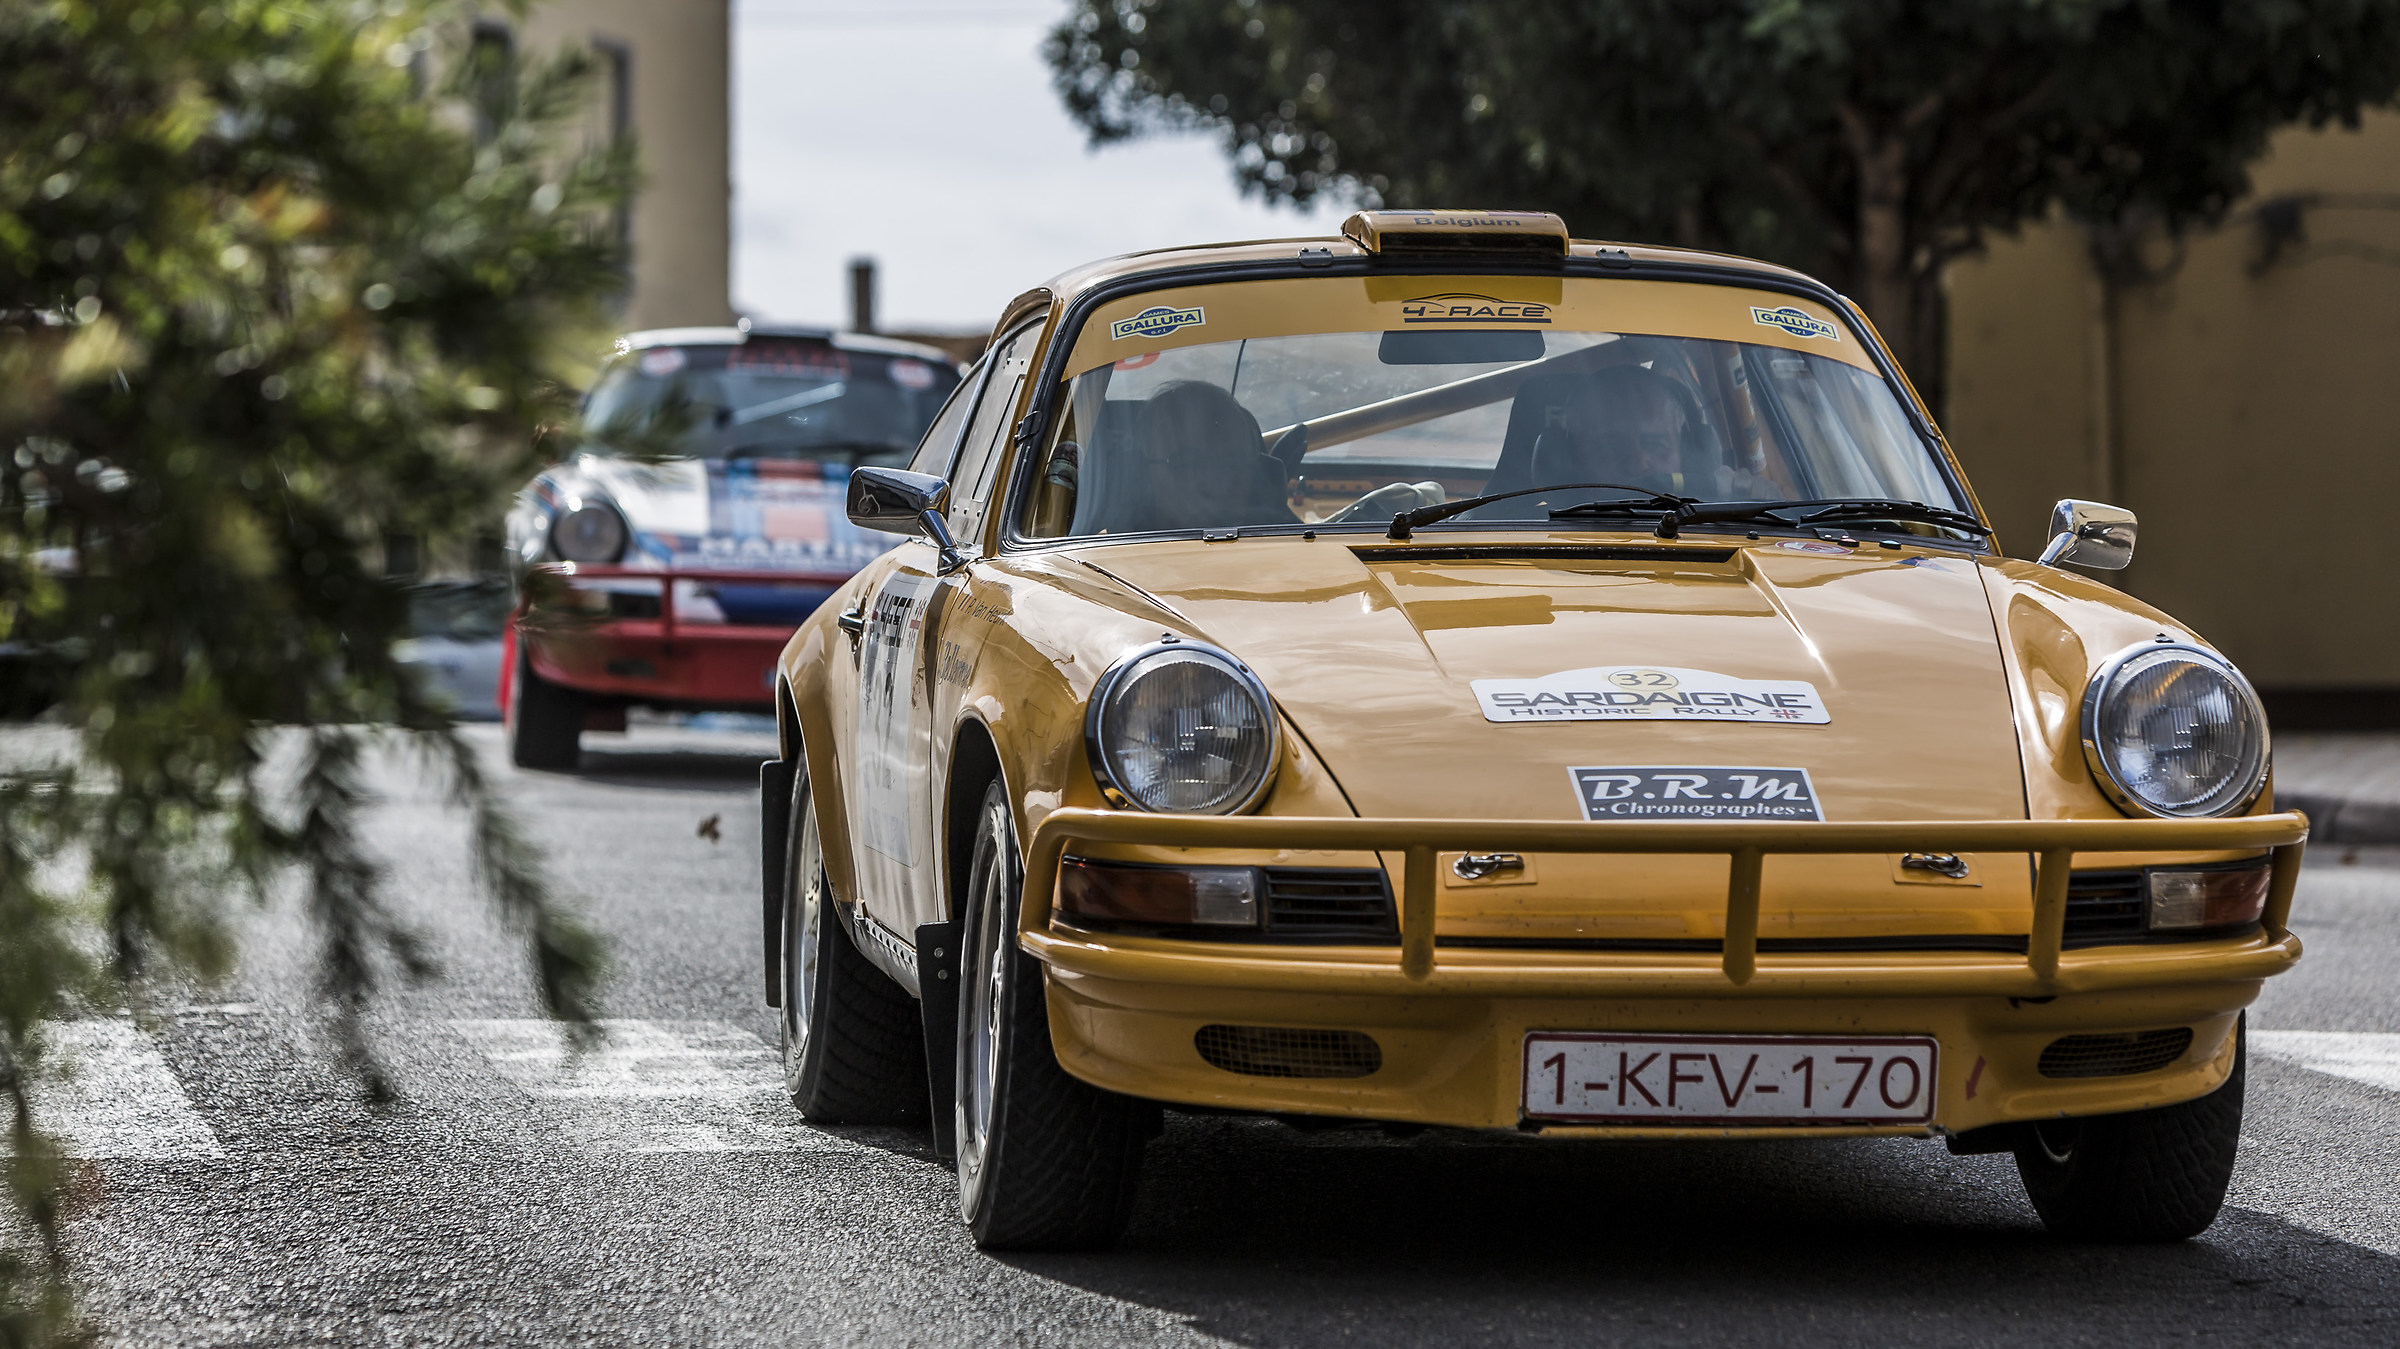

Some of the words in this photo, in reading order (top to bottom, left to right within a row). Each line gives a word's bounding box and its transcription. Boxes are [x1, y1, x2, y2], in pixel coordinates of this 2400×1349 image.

[1413, 217, 1521, 227] Belgium
[1402, 306, 1546, 317] 4-RACE
[1120, 313, 1197, 333] GALLURA
[1760, 313, 1832, 335] GALLURA
[971, 600, 988, 619] Van
[1616, 673, 1673, 687] 32
[1491, 692, 1812, 709] SARDAIGNE
[1509, 708, 1652, 716] HISTORIC
[1672, 707, 1761, 716] RALLY
[1581, 774, 1809, 801] B.R.M
[1610, 802, 1796, 818] Chronographes
[1543, 1051, 1922, 1110] 1-KFV-170
